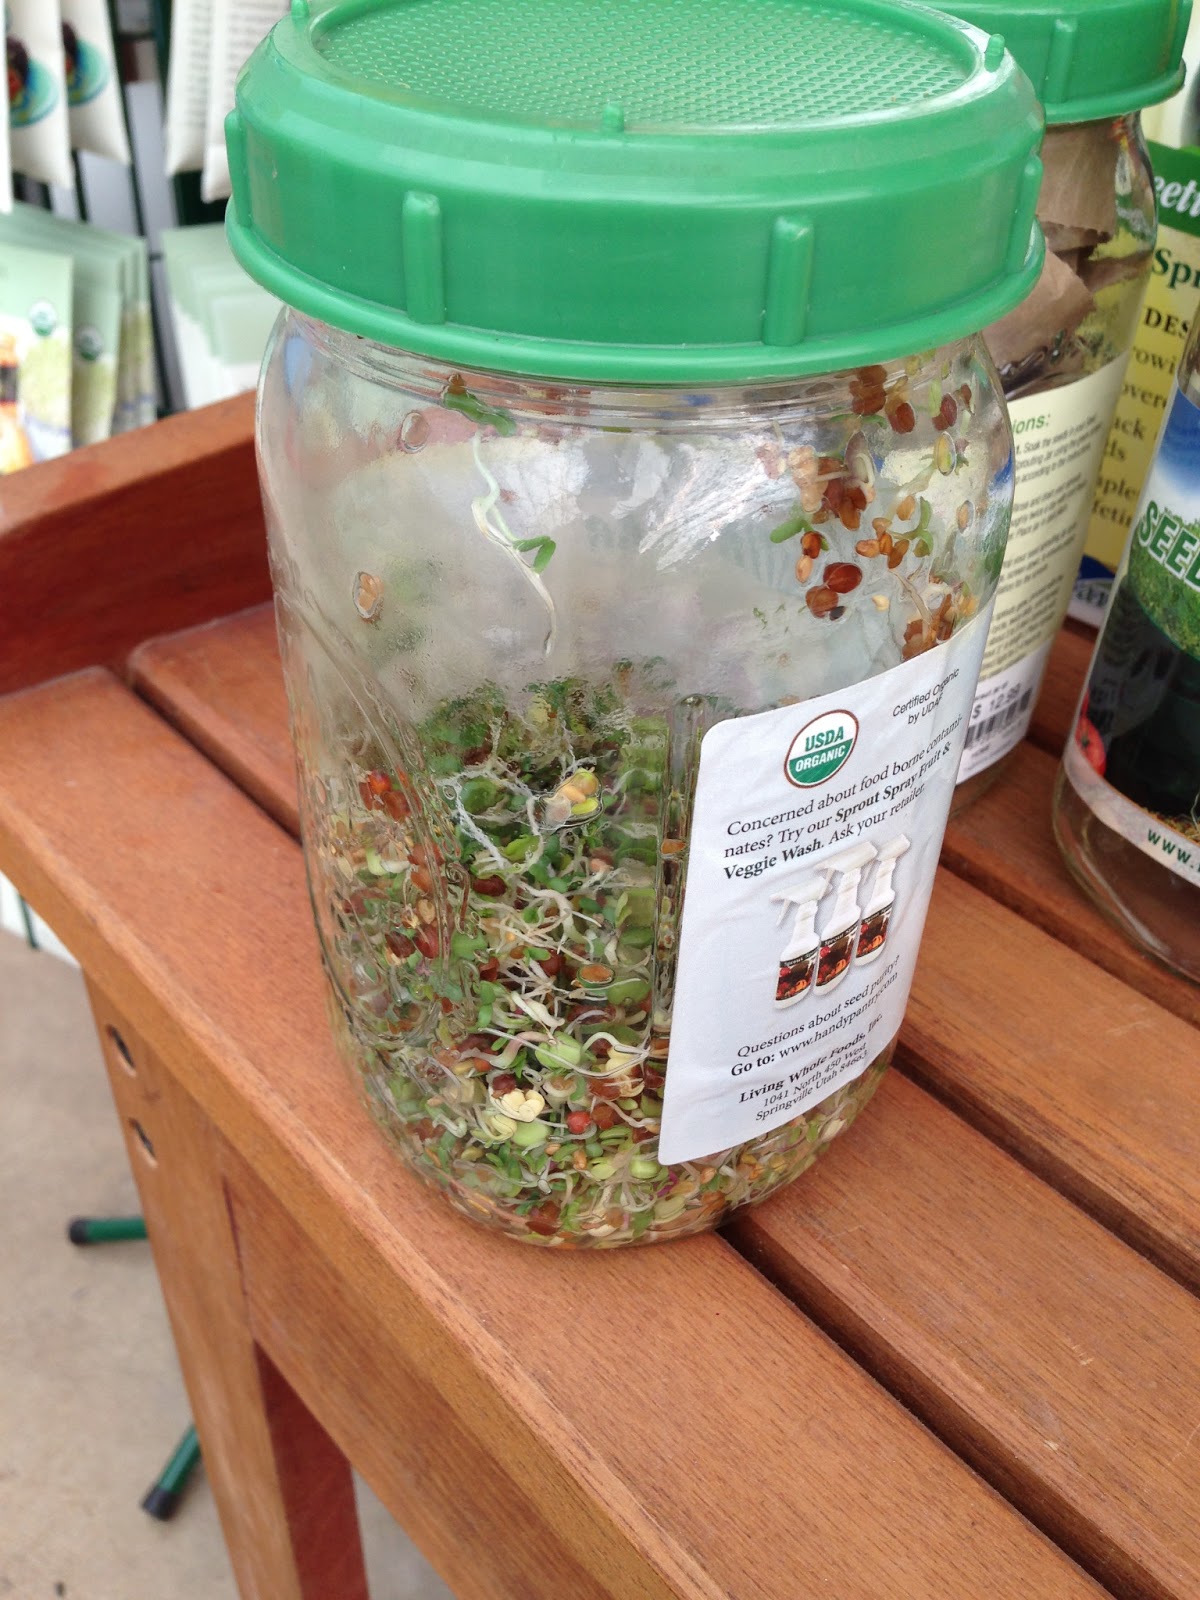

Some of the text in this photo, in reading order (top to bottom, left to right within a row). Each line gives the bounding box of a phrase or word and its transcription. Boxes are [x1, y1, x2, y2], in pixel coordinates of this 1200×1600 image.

[893, 689, 932, 717] Certified
[932, 668, 960, 696] Organic
[804, 726, 845, 752] USDA
[907, 712, 920, 725] by
[727, 800, 814, 836] Concerned
[818, 784, 857, 811] about
[859, 766, 890, 792] food
[892, 749, 925, 776] borne
[926, 713, 963, 754] contami-
[795, 746, 846, 773] ORGANIC
[724, 835, 773, 858] nates?
[777, 826, 804, 846] Try
[807, 815, 833, 834] our
[834, 791, 880, 823] Sprout
[882, 775, 918, 807] Spray
[917, 750, 942, 779] Fruit
[942, 740, 953, 756] &
[723, 783, 927, 882] Veggie Wash. Ask your retailer.
[1148, 829, 1200, 873] www.
[731, 972, 898, 1077] Go to: www.handypantry.com
[737, 955, 901, 1058] Questions about seed purity?
[738, 1078, 784, 1104] Living
[788, 1055, 827, 1085] Whole
[755, 1087, 814, 1121] Springville
[816, 1070, 838, 1090] Utah
[763, 1042, 868, 1108] 1041 North 450 West
